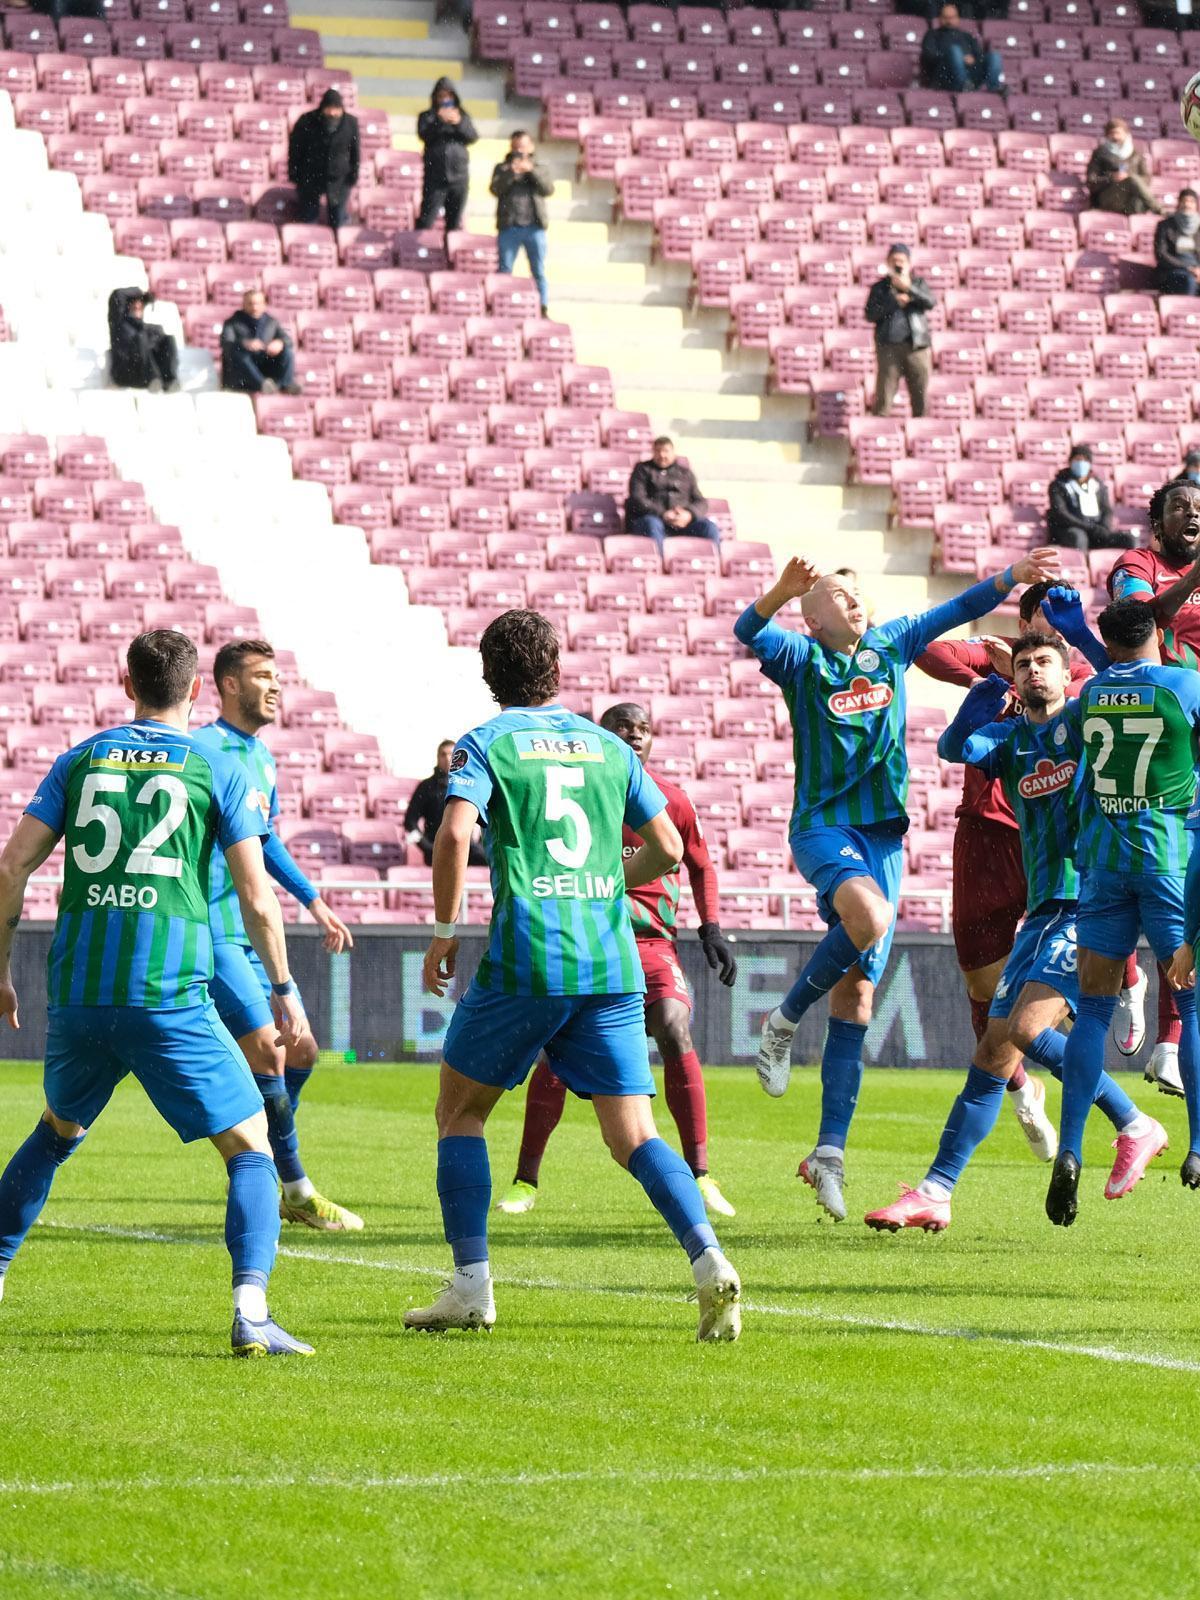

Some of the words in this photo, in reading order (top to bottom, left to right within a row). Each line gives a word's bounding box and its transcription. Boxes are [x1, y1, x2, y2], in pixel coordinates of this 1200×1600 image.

[1098, 691, 1141, 707] aksa
[108, 748, 170, 764] aksa
[532, 738, 588, 755] aksa
[1083, 717, 1164, 798] 27
[1023, 765, 1074, 796] ÇAYKUR
[71, 773, 189, 877] 52
[544, 765, 593, 869] 5
[87, 884, 158, 909] SABO
[1049, 939, 1078, 973] 19
